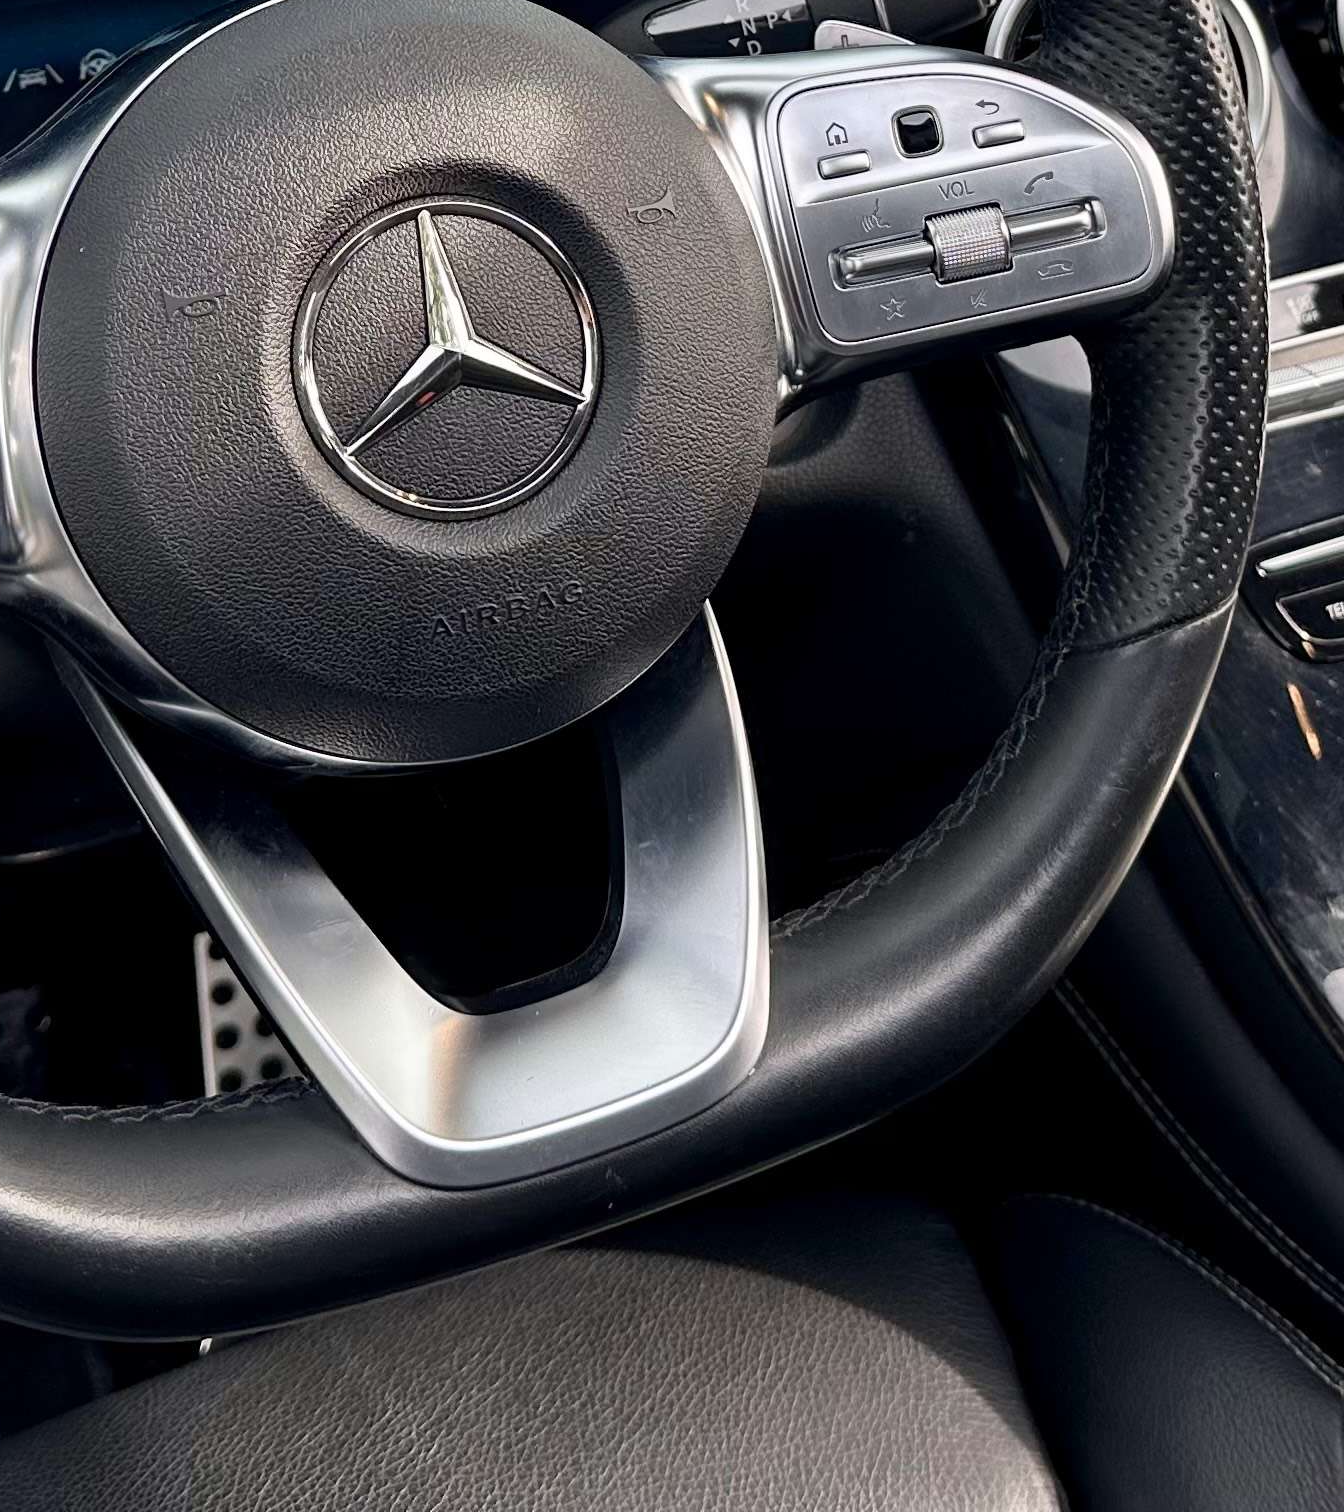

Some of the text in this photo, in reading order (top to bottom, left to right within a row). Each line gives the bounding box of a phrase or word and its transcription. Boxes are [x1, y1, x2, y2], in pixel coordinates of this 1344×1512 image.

[740, 11, 779, 37] N P
[746, 39, 763, 57] D
[937, 177, 975, 200] VOL
[428, 578, 586, 640] AIRBAG
